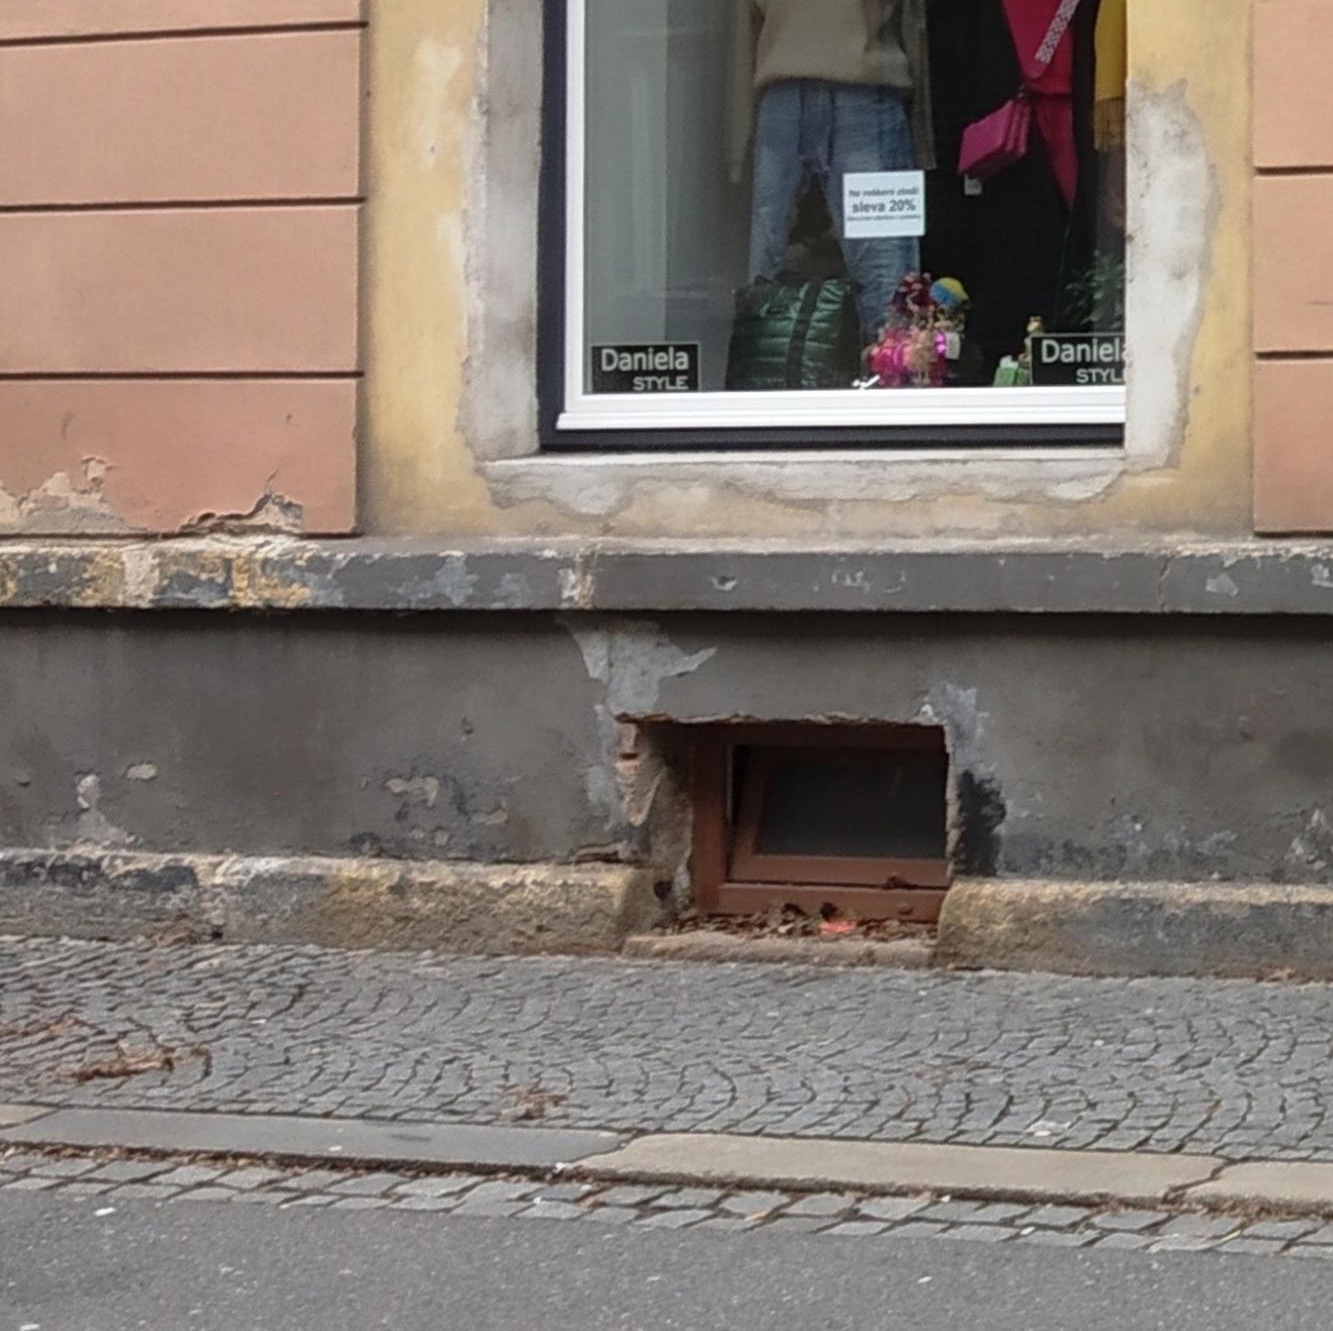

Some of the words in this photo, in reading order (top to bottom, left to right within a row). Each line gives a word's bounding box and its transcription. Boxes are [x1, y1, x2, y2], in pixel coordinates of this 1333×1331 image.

[852, 201, 886, 213] sleva
[888, 199, 917, 212] 20%
[601, 346, 690, 372] Daniela
[632, 375, 689, 392] STYLE
[1076, 368, 1127, 384] STYL
